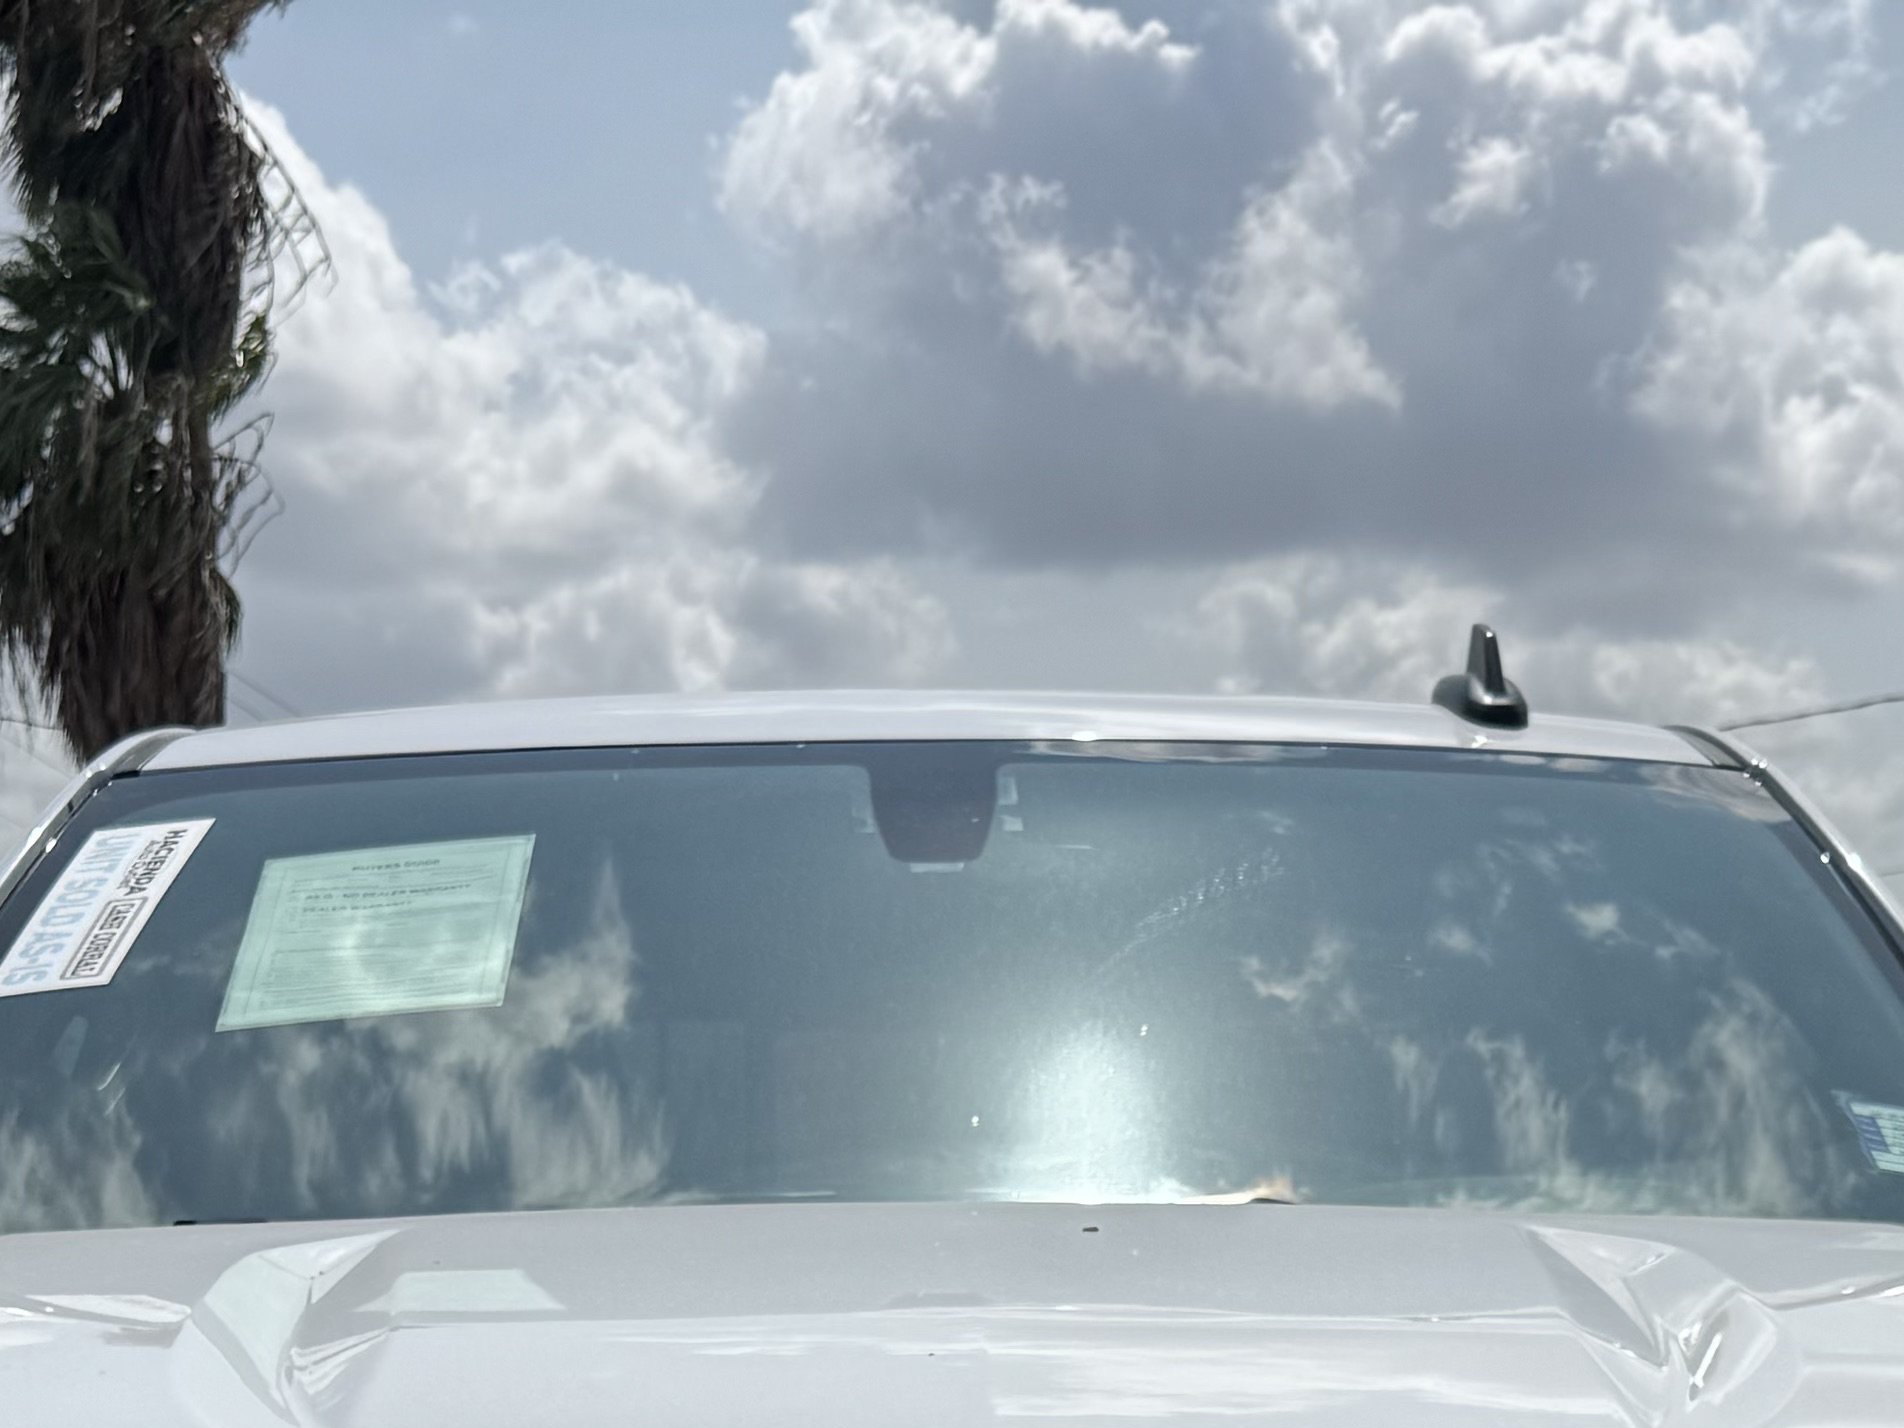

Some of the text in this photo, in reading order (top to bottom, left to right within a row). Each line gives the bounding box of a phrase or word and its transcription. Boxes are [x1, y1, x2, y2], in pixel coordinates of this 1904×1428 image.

[0, 834, 140, 986] UNIT SOLD AS-IS
[124, 829, 188, 896] HACIENDA
